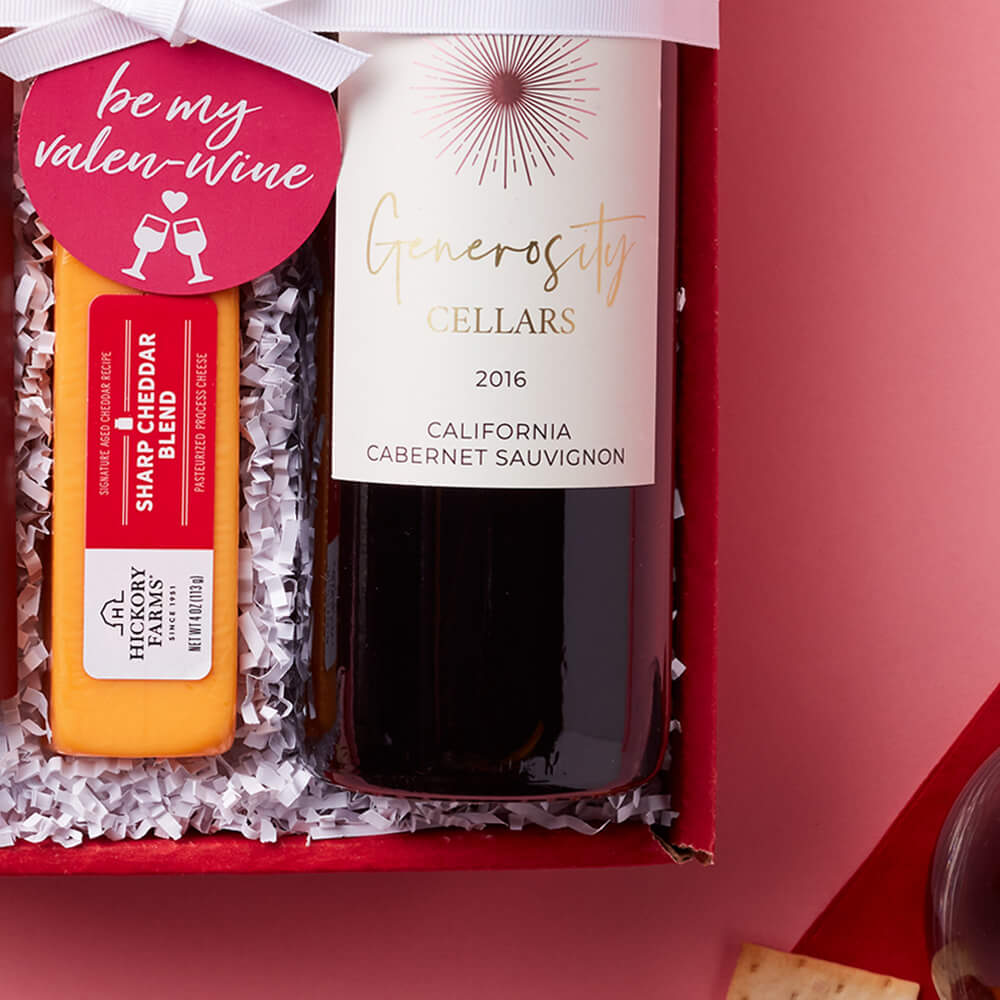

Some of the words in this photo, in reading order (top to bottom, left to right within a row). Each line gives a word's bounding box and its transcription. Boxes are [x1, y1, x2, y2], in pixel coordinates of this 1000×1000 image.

[96, 60, 161, 119] be
[165, 94, 263, 150] my
[365, 191, 647, 308] Generosity
[426, 306, 577, 335] CELLARS
[101, 351, 112, 381] RECIPE
[195, 352, 208, 388] CHEESE
[475, 370, 527, 388] 2016
[137, 332, 156, 434] CHEDDAR
[100, 383, 112, 423] CHEDDAR
[194, 389, 207, 430] PROCESS
[100, 425, 111, 448] AGED
[158, 390, 176, 460] BLEND
[427, 421, 571, 441] CALIFORNIA
[194, 433, 207, 493] PASTEURIZED
[366, 445, 489, 467] CABERNET
[495, 446, 625, 467] SAUVIGNON
[99, 450, 110, 496] SIGNATURE
[136, 439, 154, 512] SHARP
[112, 608, 124, 619] H
[129, 566, 146, 660] HICKORY
[148, 579, 163, 647] FARMS
[189, 604, 202, 614] OZ
[189, 614, 202, 622] 4
[168, 611, 176, 641] SINCE
[188, 622, 202, 635] WT
[188, 637, 201, 652] NET
